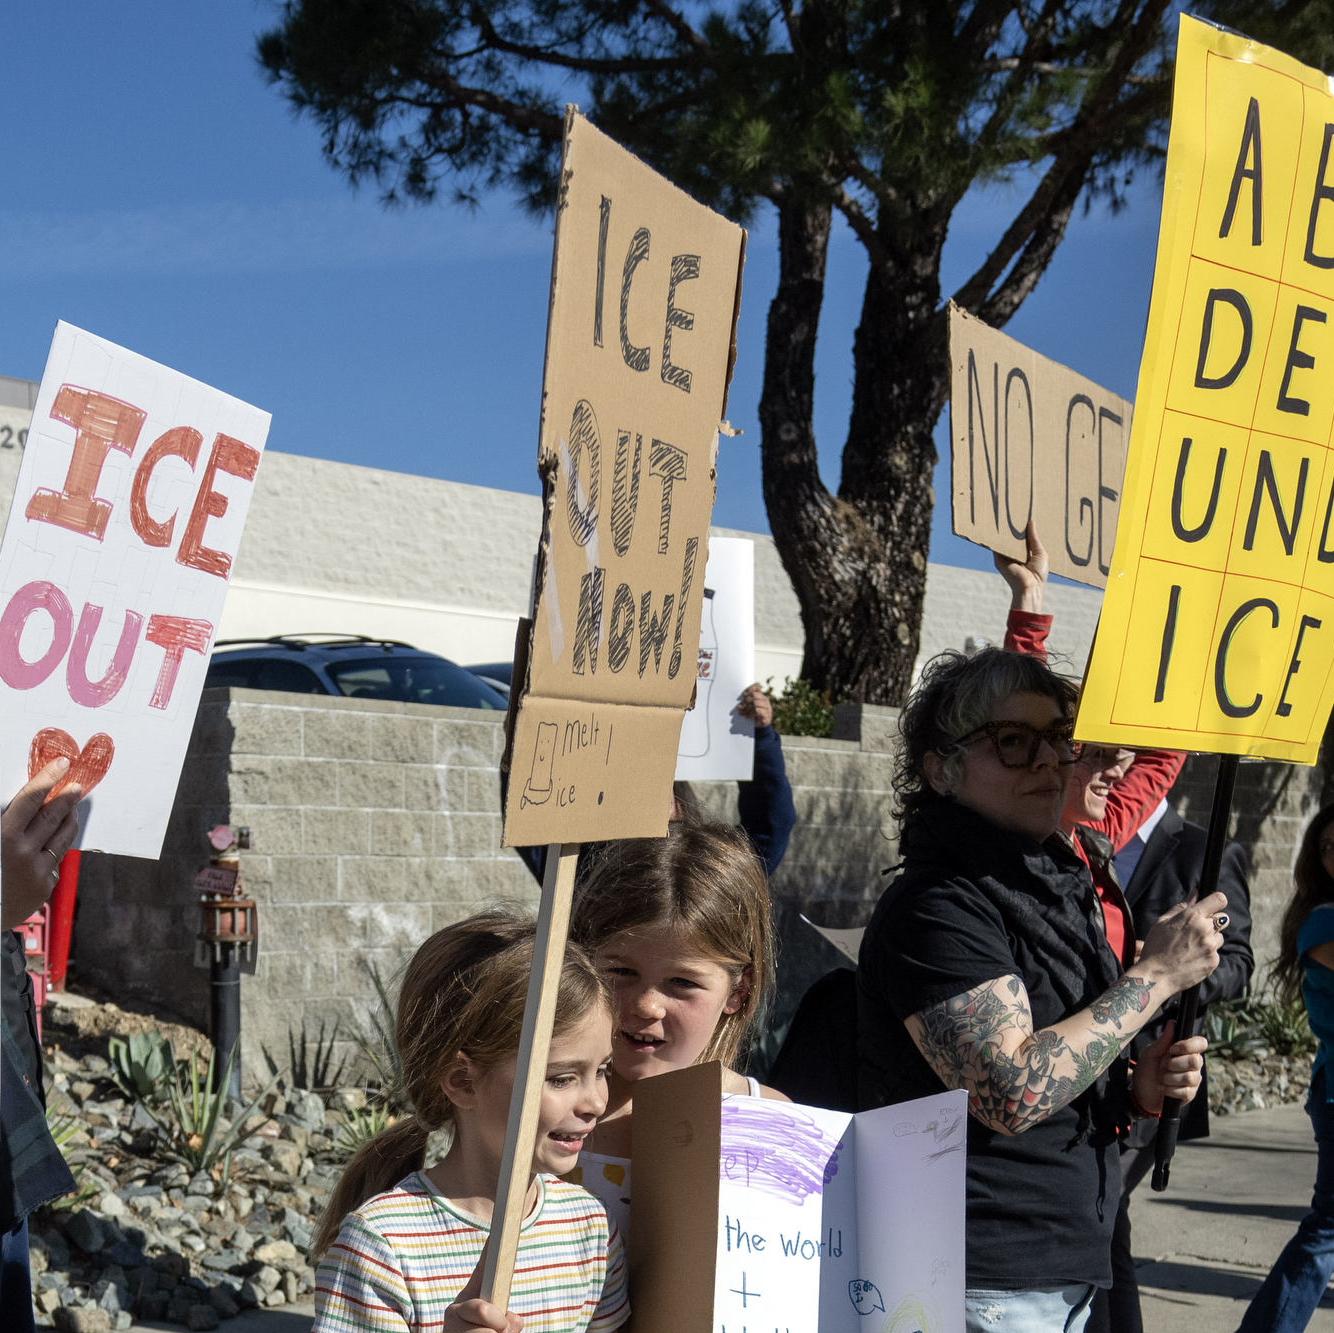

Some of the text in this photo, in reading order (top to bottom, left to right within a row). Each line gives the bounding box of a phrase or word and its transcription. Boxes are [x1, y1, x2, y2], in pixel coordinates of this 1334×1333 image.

[593, 194, 701, 394] ICE
[25, 383, 261, 581] ICE
[567, 399, 689, 557] OUT
[967, 347, 1033, 541] NO
[1153, 584, 1323, 719] ICE
[725, 1215, 766, 1253] the
